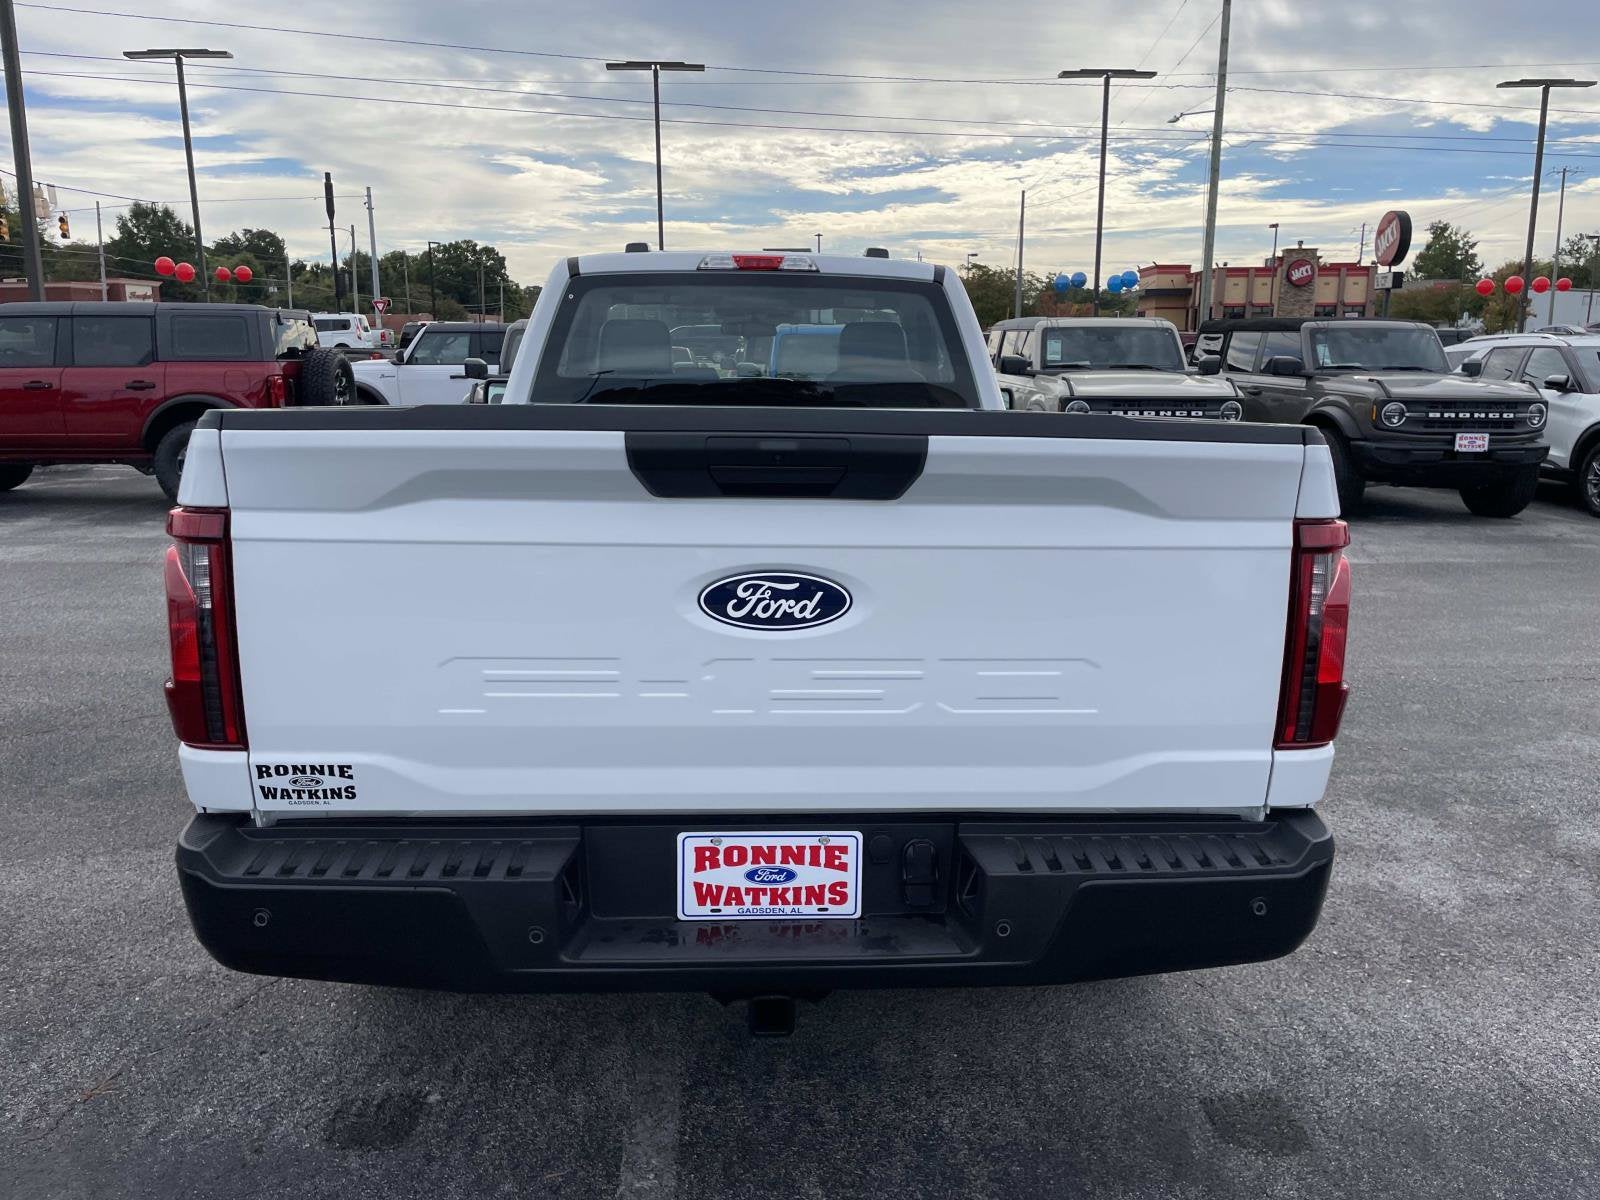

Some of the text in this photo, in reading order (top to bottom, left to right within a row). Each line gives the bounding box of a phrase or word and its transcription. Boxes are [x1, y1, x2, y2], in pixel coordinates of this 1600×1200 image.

[726, 580, 824, 619] Ford
[255, 764, 354, 780] RONNIE
[259, 785, 357, 800] WATKINS
[694, 845, 849, 874] RONNIE
[754, 867, 788, 882] Ford
[693, 881, 849, 907] WATKINS
